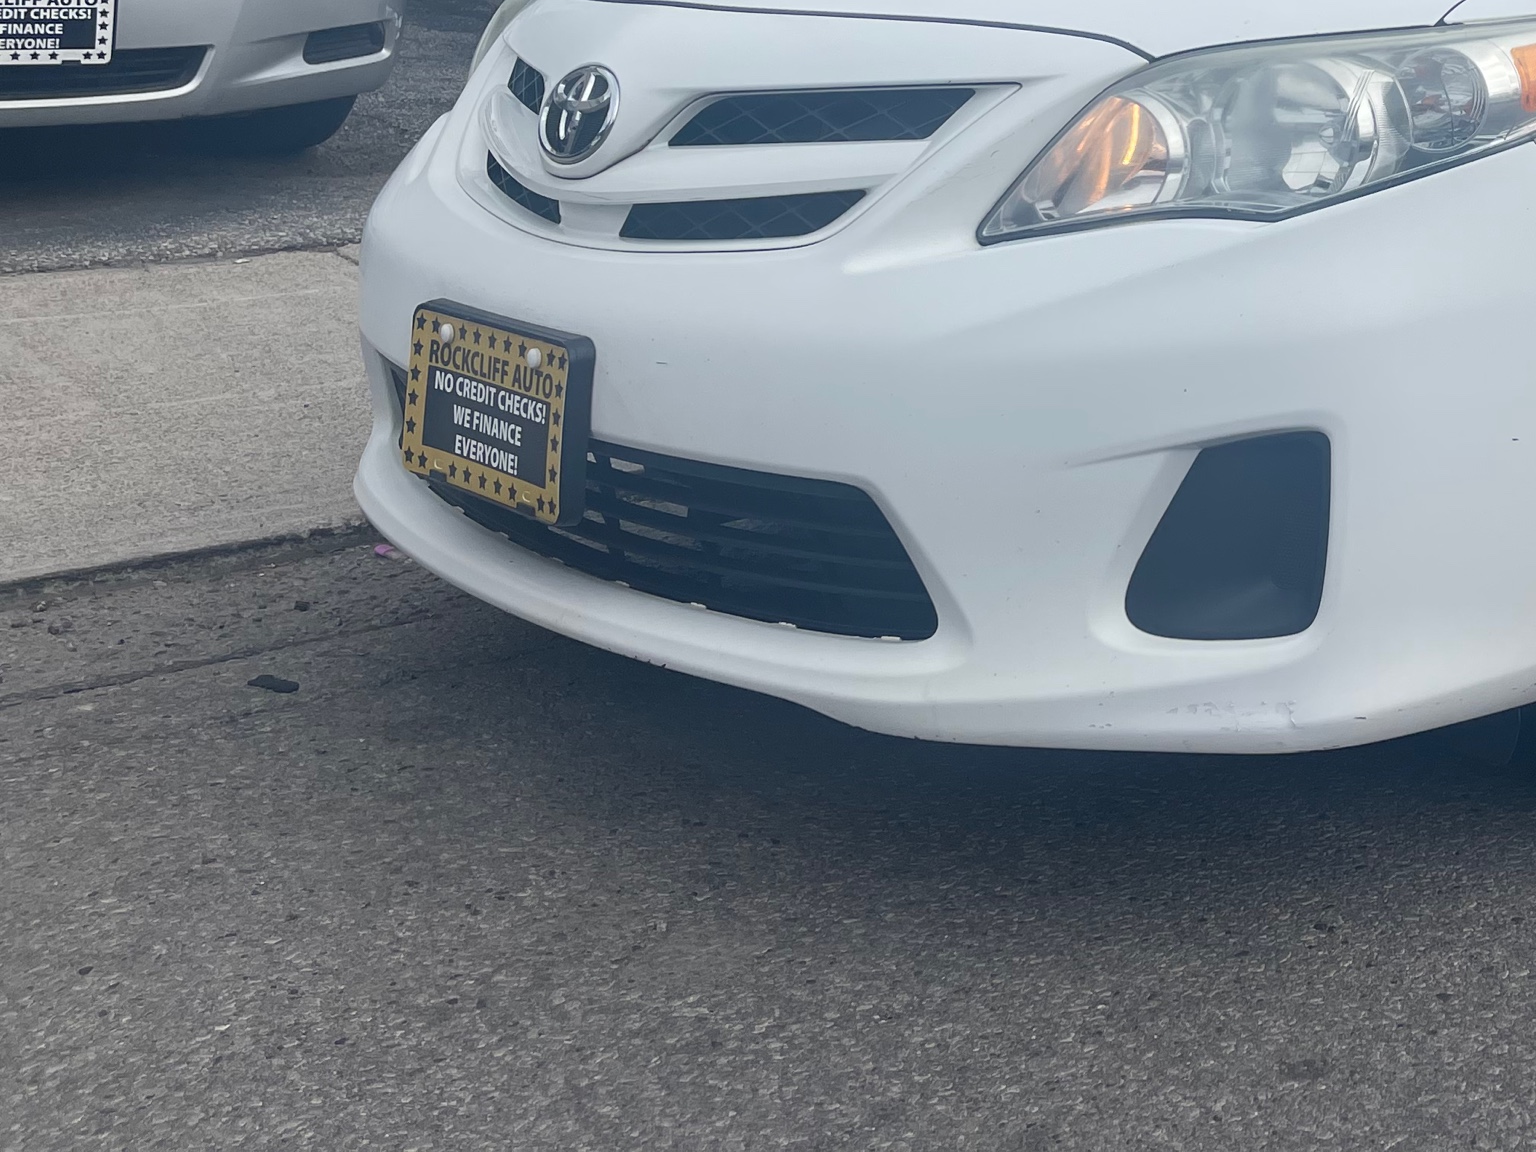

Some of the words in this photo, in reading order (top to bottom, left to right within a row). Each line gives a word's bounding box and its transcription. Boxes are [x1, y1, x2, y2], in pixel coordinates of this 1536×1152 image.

[30, 8, 92, 20] CHECKS!
[429, 338, 509, 385] ROCKCLIFF
[511, 363, 553, 399] AUTO
[434, 370, 454, 394] NO
[456, 376, 497, 408] CREDIT
[497, 390, 547, 425] CHECKS!
[453, 404, 471, 429] WE
[472, 412, 522, 447] FINANCE
[454, 434, 518, 476] EVERYONE!
